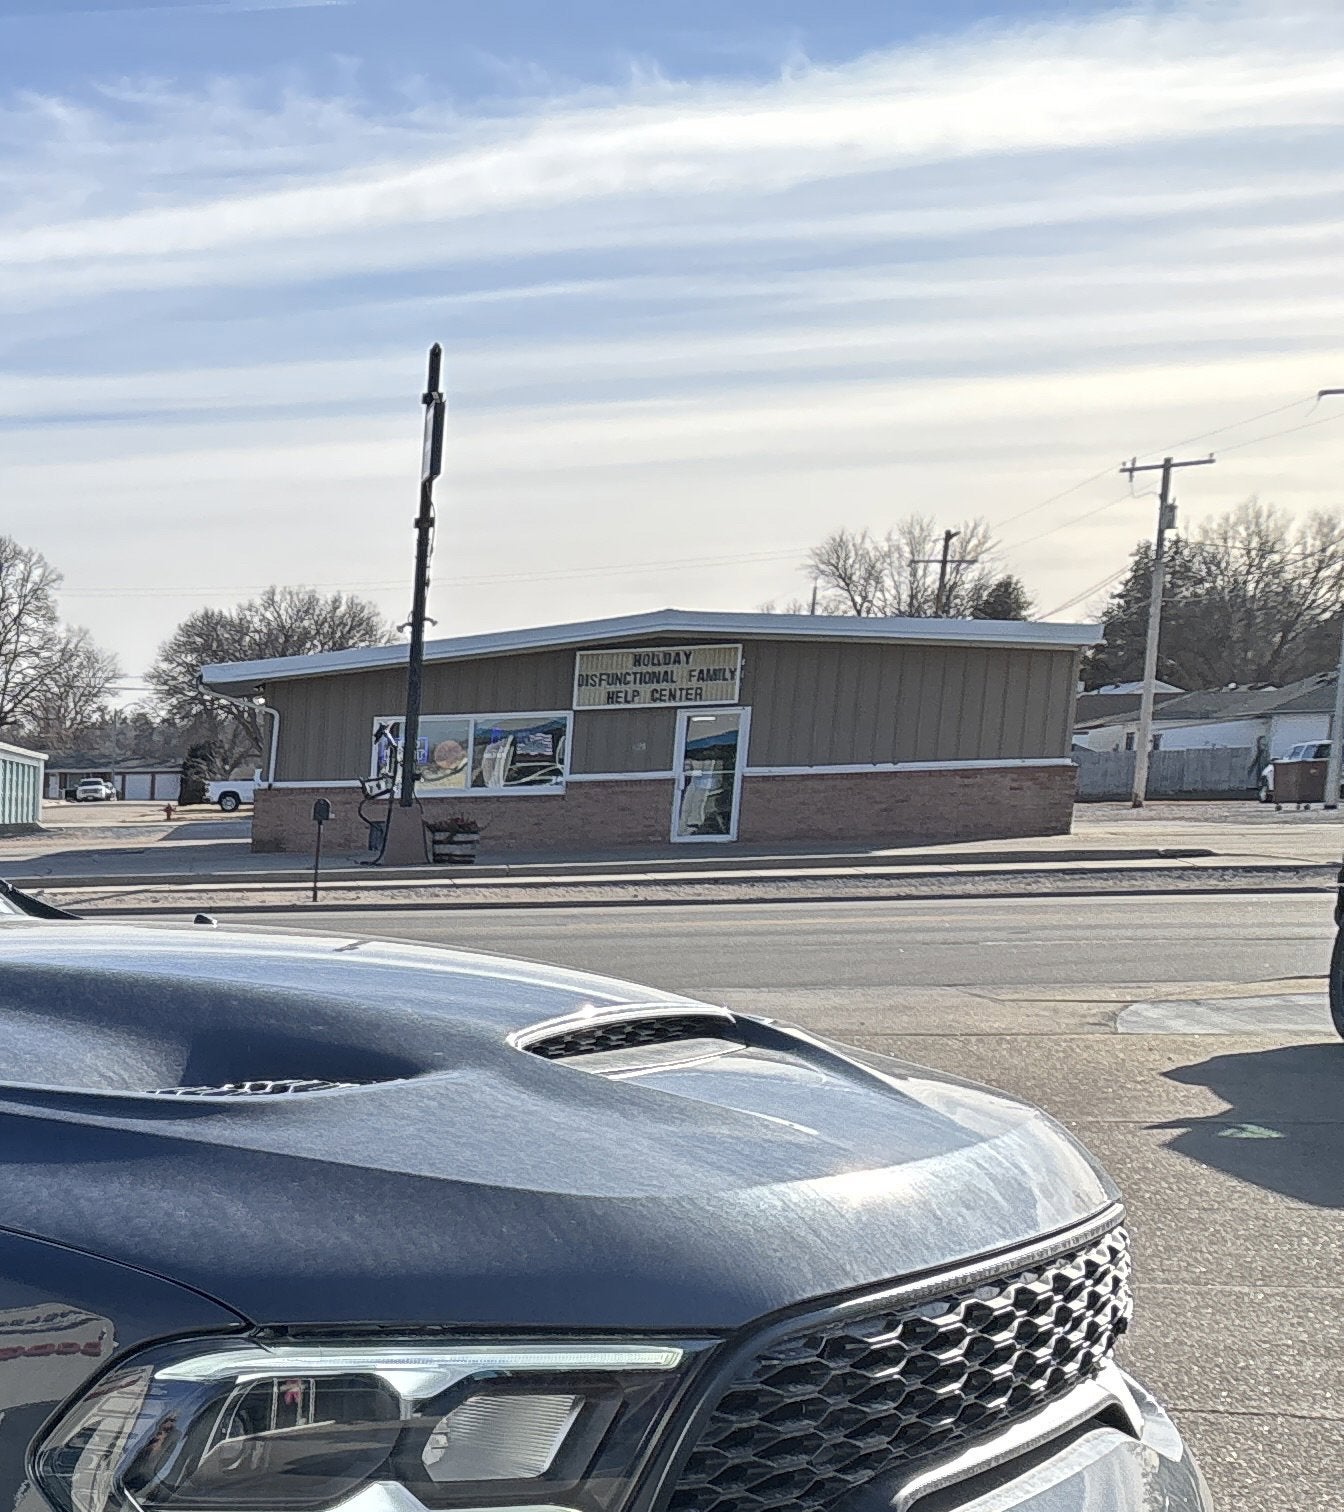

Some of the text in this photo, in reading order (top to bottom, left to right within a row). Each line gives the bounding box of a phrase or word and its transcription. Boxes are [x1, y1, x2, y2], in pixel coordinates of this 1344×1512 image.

[632, 650, 694, 668] HOLIDAY
[577, 667, 738, 688] DISFUNCTIONAL FAMILY
[606, 686, 704, 705] HELP CENTER
